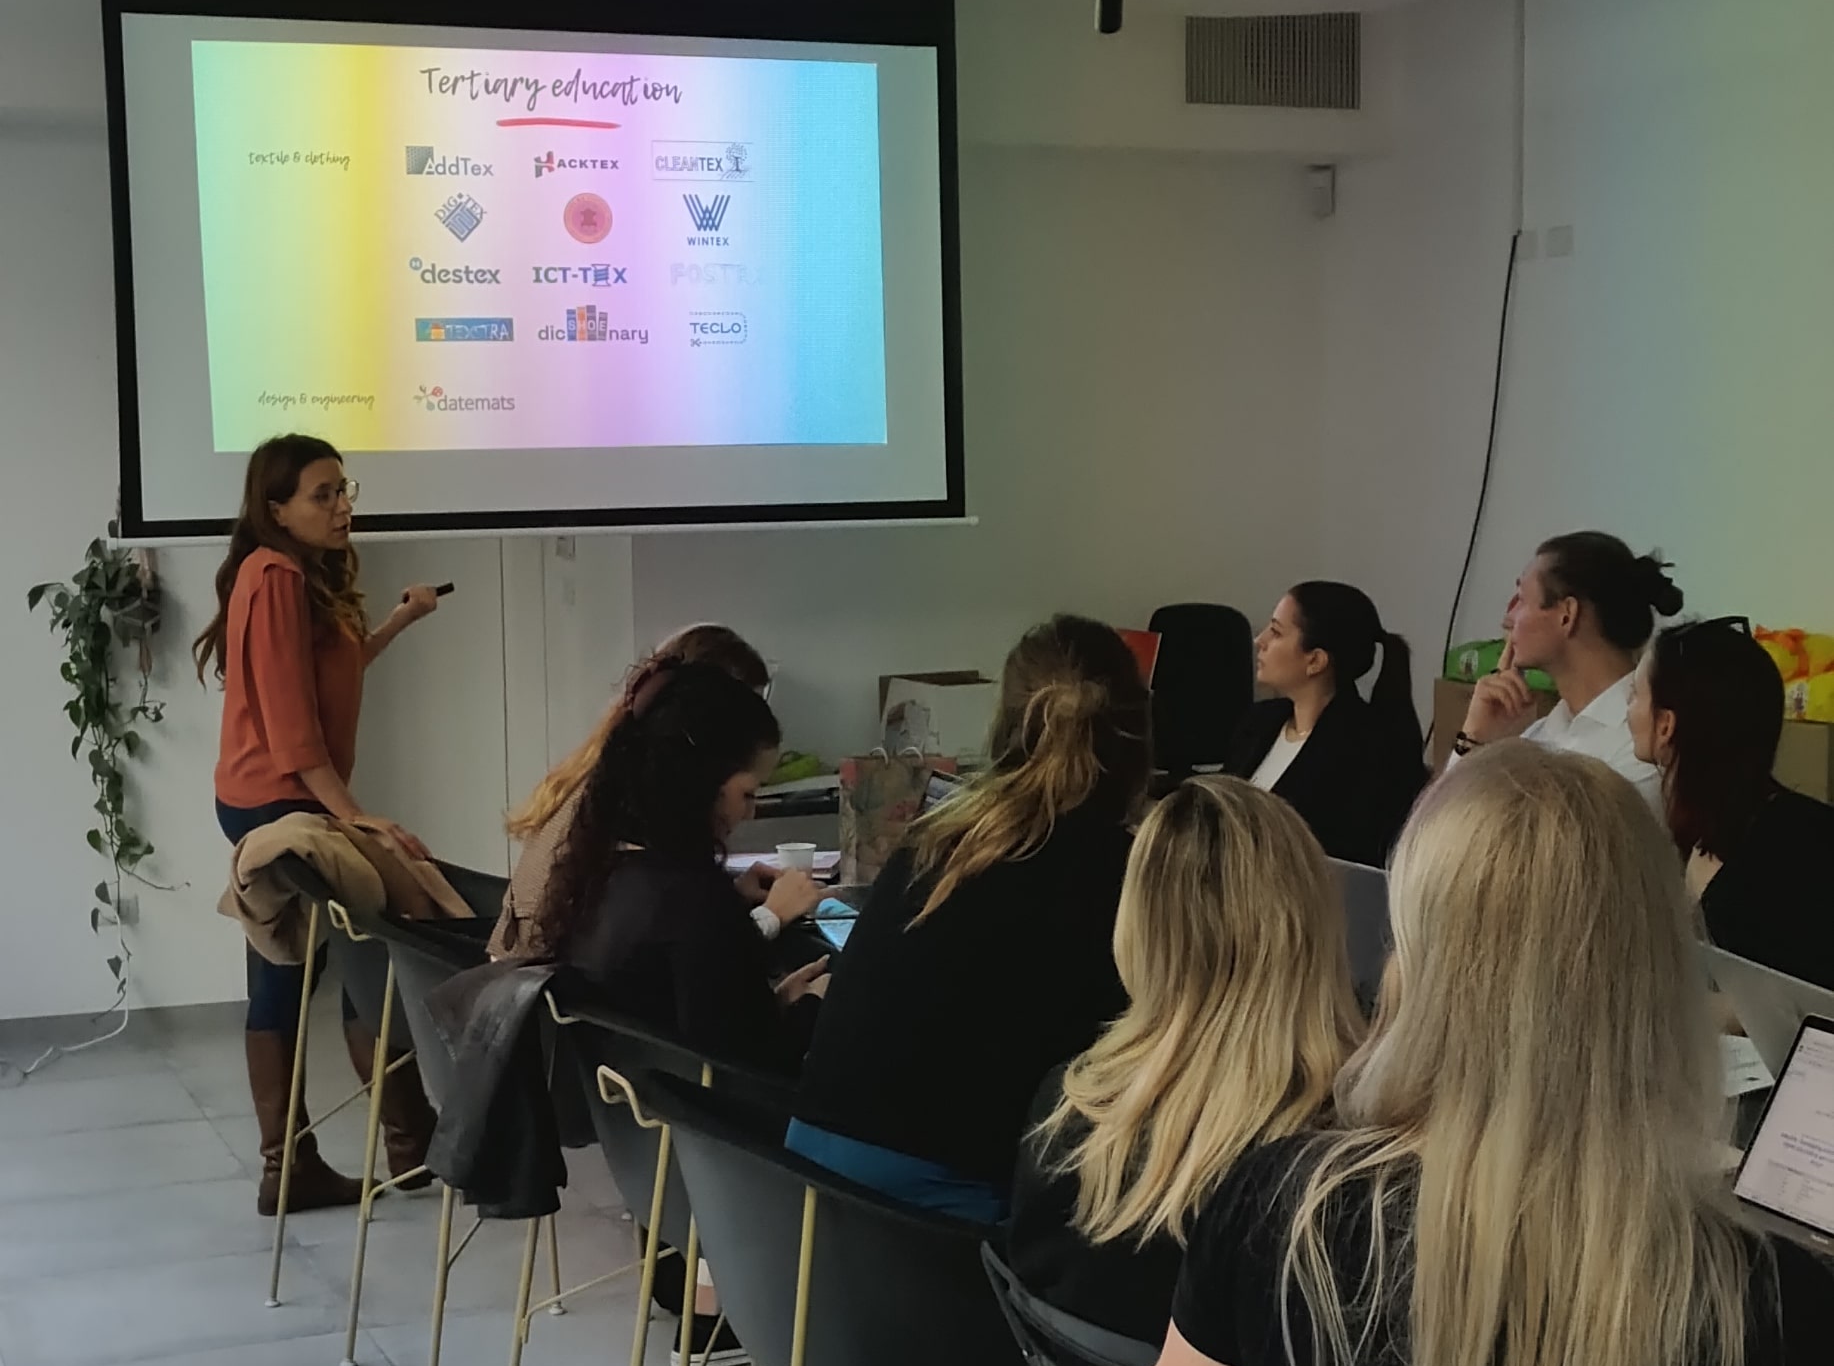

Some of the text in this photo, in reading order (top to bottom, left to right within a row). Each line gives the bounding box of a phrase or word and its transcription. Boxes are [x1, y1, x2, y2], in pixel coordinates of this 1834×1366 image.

[419, 67, 683, 112] Tertiary education
[249, 150, 290, 165] textile
[305, 151, 350, 171] clothing
[423, 155, 494, 176] AddTex
[687, 236, 729, 246] WINTEX
[420, 263, 501, 284] destex
[689, 322, 741, 334] TECLO
[258, 390, 297, 411] design
[311, 394, 375, 411] engineering
[437, 395, 515, 411] datemats
